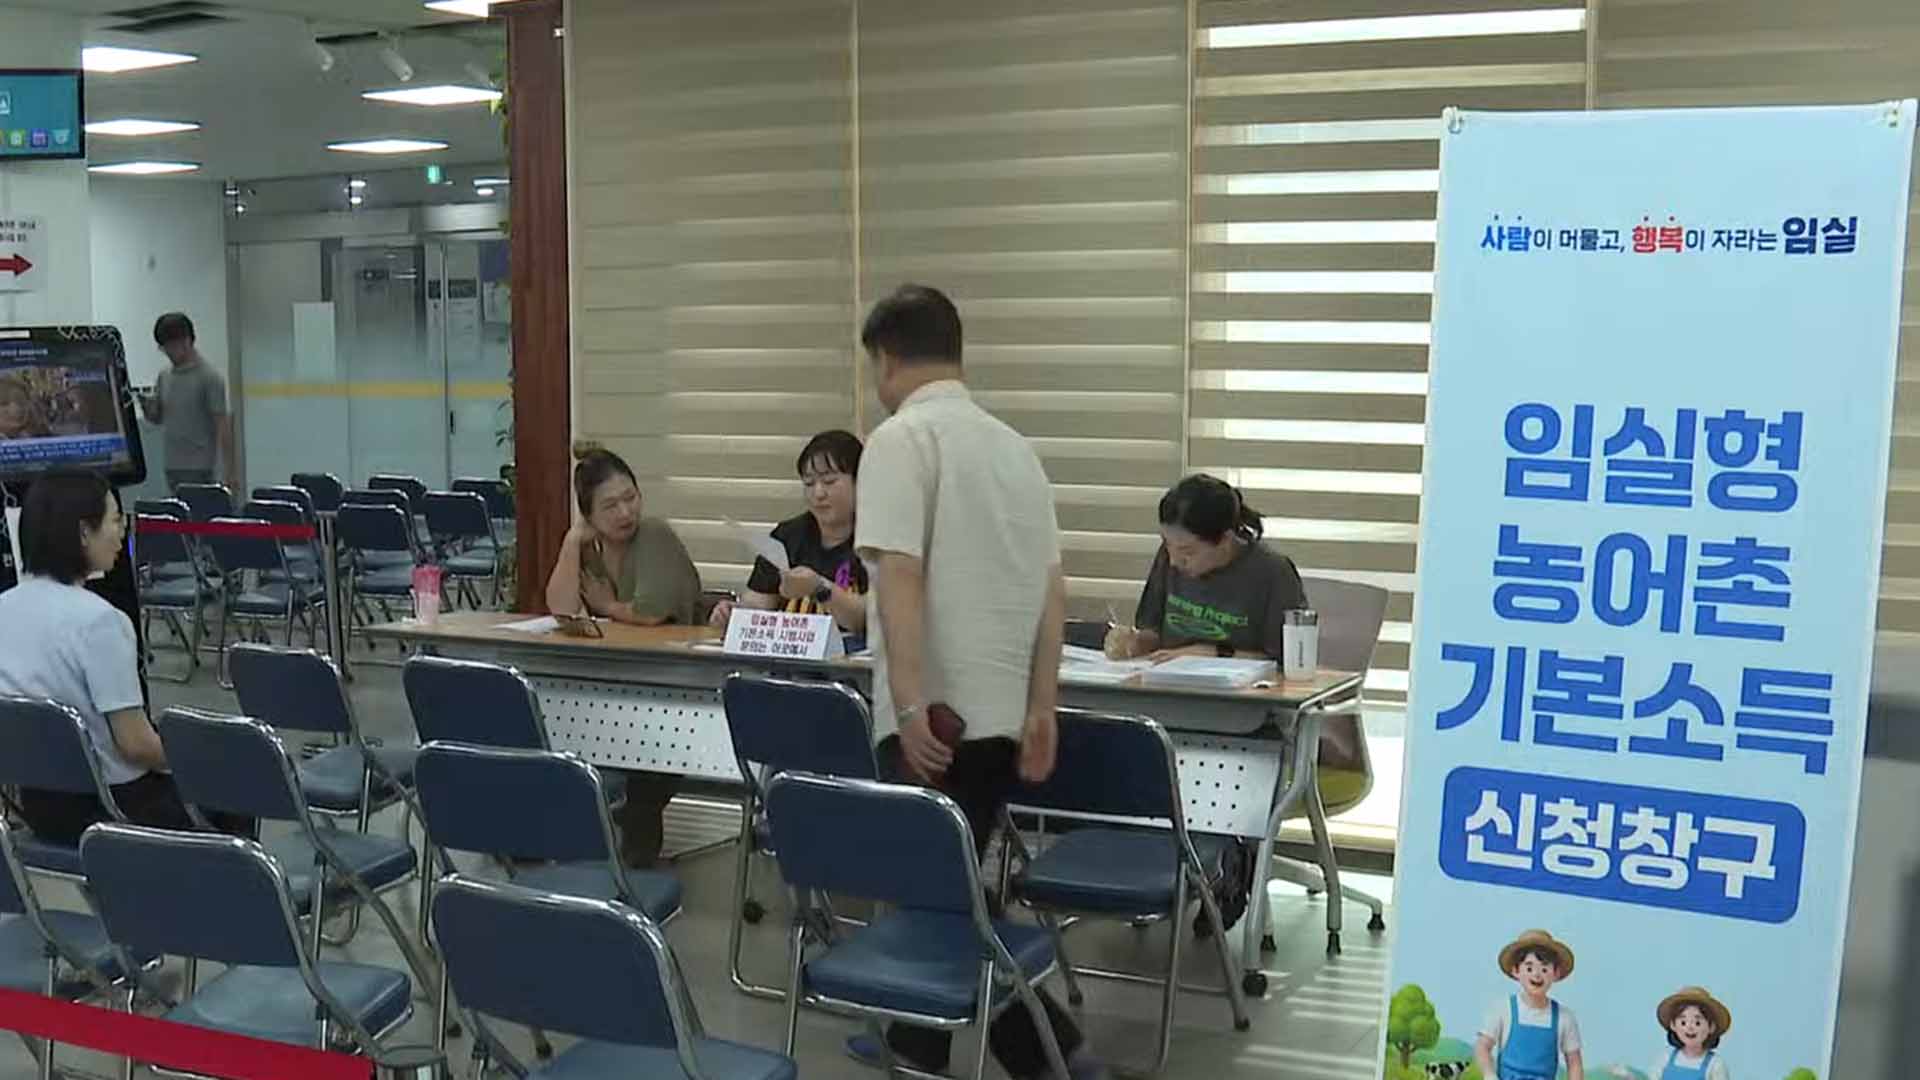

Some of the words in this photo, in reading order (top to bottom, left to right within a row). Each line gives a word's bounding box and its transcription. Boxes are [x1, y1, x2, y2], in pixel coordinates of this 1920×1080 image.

[1480, 221, 1552, 252] 사람이
[1559, 228, 1626, 254] 머물고,
[1632, 221, 1705, 254] 행복이
[1712, 228, 1777, 253] 자라는
[1782, 215, 1858, 254] 임실
[1503, 402, 1804, 513] 임실형
[1492, 523, 1792, 642] 농어촌
[1435, 642, 1834, 775] 기본소득
[1464, 789, 1777, 900] 신청창구
